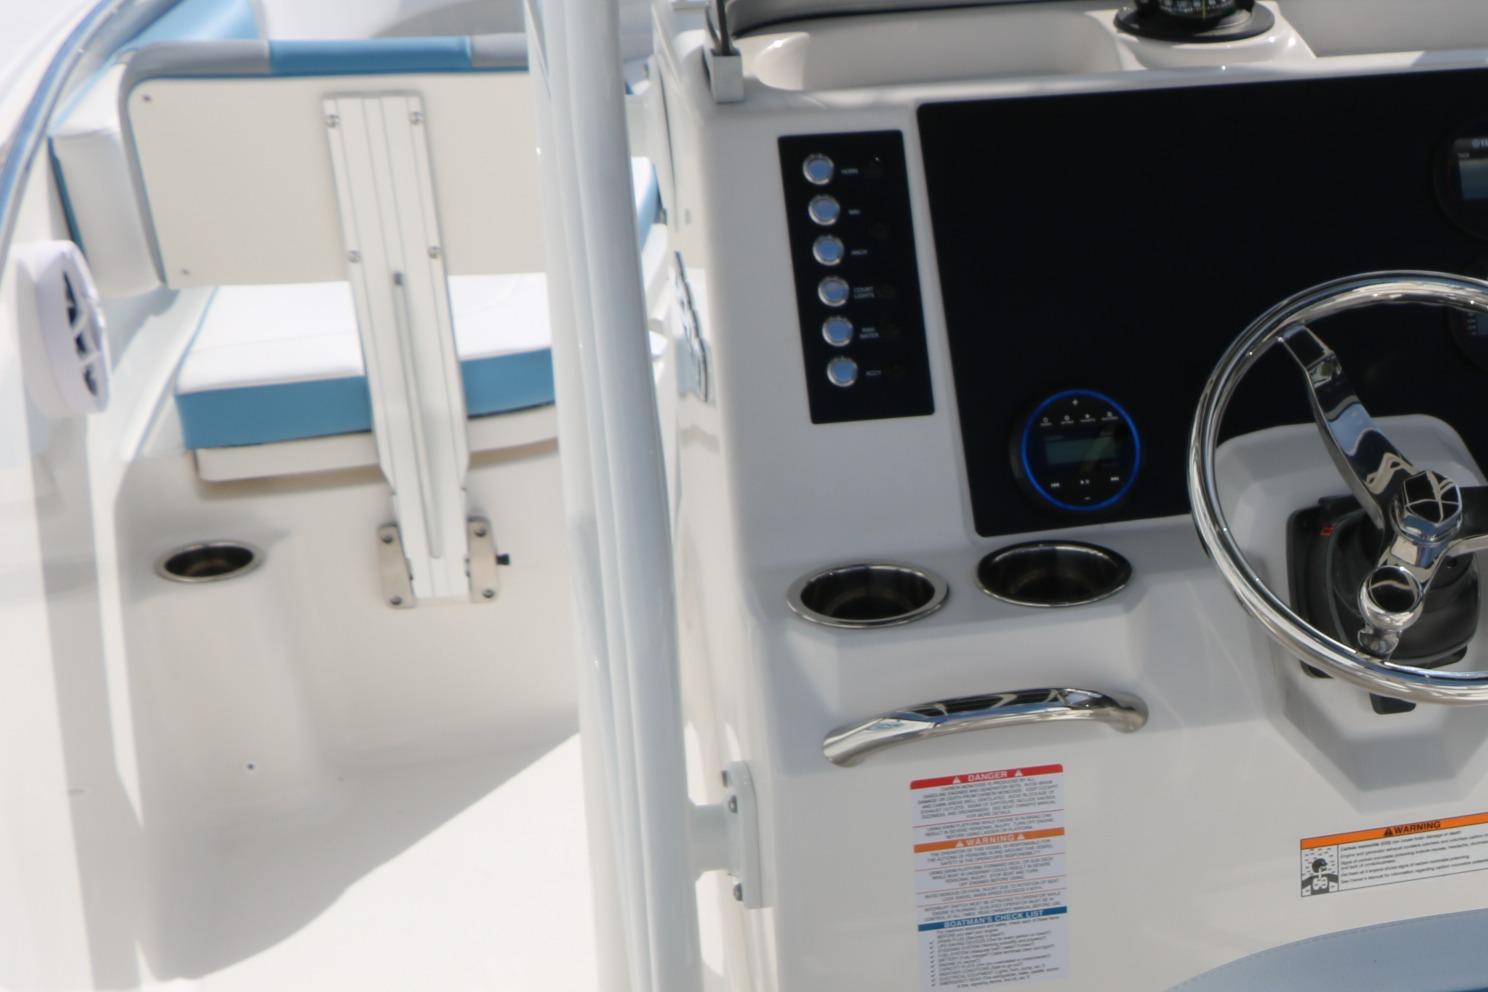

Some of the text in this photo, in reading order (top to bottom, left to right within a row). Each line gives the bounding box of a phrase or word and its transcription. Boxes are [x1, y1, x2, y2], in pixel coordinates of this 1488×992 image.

[967, 770, 1008, 782] DANGER
[1392, 820, 1441, 835] WARNING
[966, 834, 1015, 846] WARNING
[944, 909, 1044, 928] BOATMAN'S CHECK LIST
